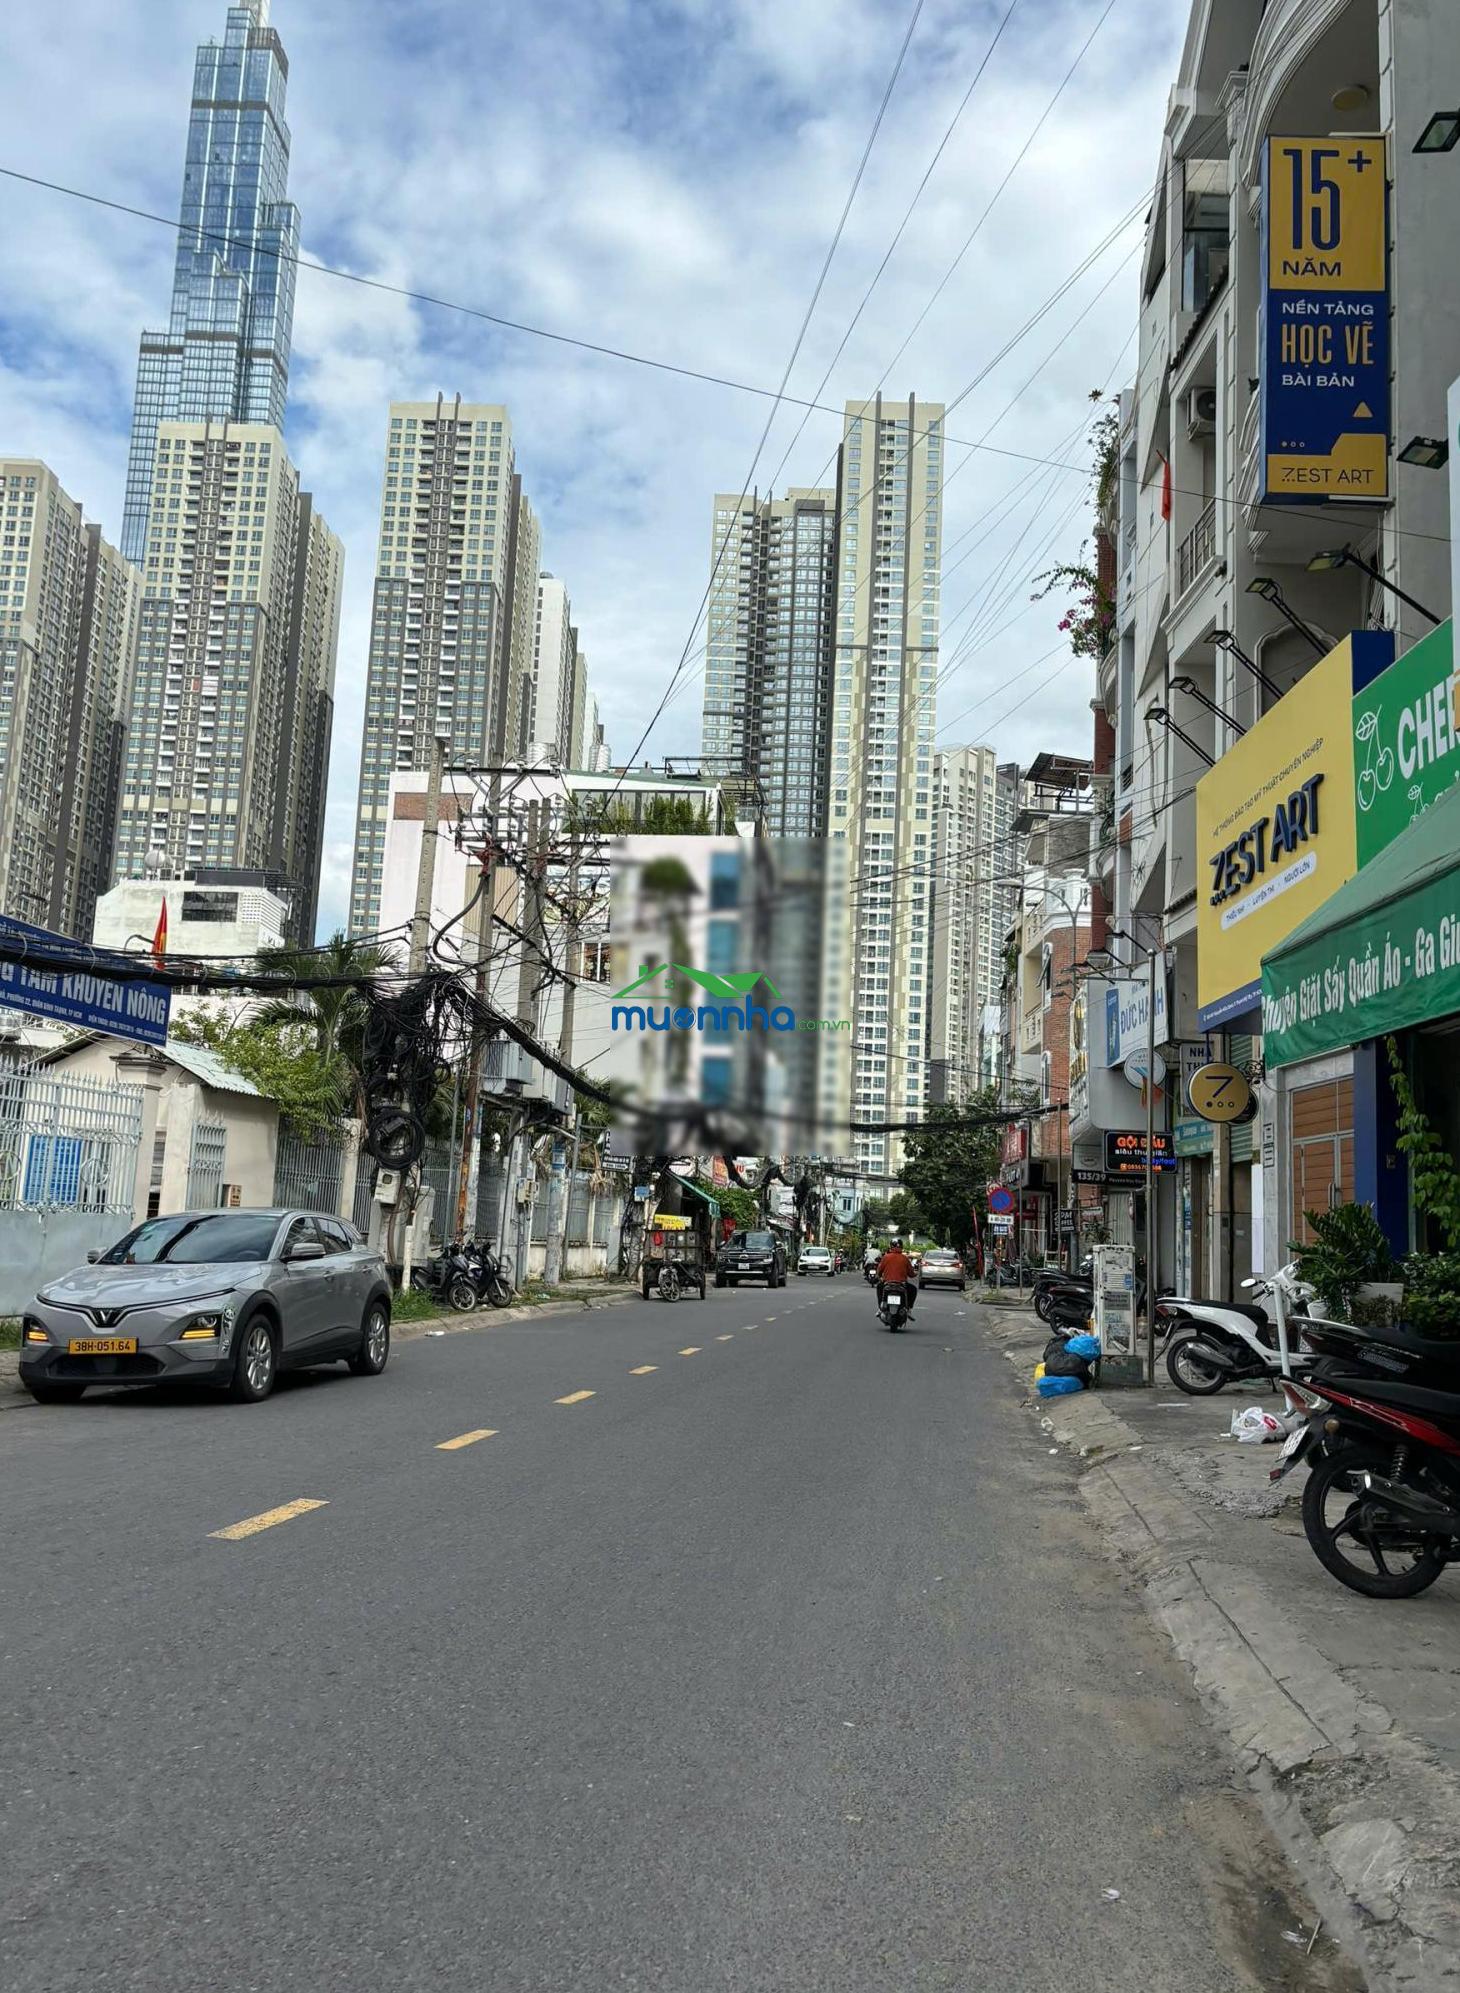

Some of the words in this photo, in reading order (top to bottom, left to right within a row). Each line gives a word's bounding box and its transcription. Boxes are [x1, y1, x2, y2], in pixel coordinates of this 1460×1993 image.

[1283, 257, 1342, 277] NĂM
[1324, 301, 1374, 316] TẢNG
[1281, 323, 1332, 368] HỌC
[1345, 321, 1375, 366] VẼ
[1282, 372, 1311, 387] BÀI
[1316, 373, 1355, 388] BẢN
[1337, 469, 1375, 484] ART
[1209, 817, 1270, 906] ZEST
[1270, 773, 1325, 863] ART
[1300, 973, 1322, 1027] Giặt
[1324, 955, 1346, 1013] Sấy
[1349, 941, 1380, 1008] Quần
[1383, 931, 1401, 991] Áo
[1415, 927, 1436, 979] Ga
[126, 986, 168, 1026] NÔNG
[75, 1340, 131, 1352] 38H-051.64
